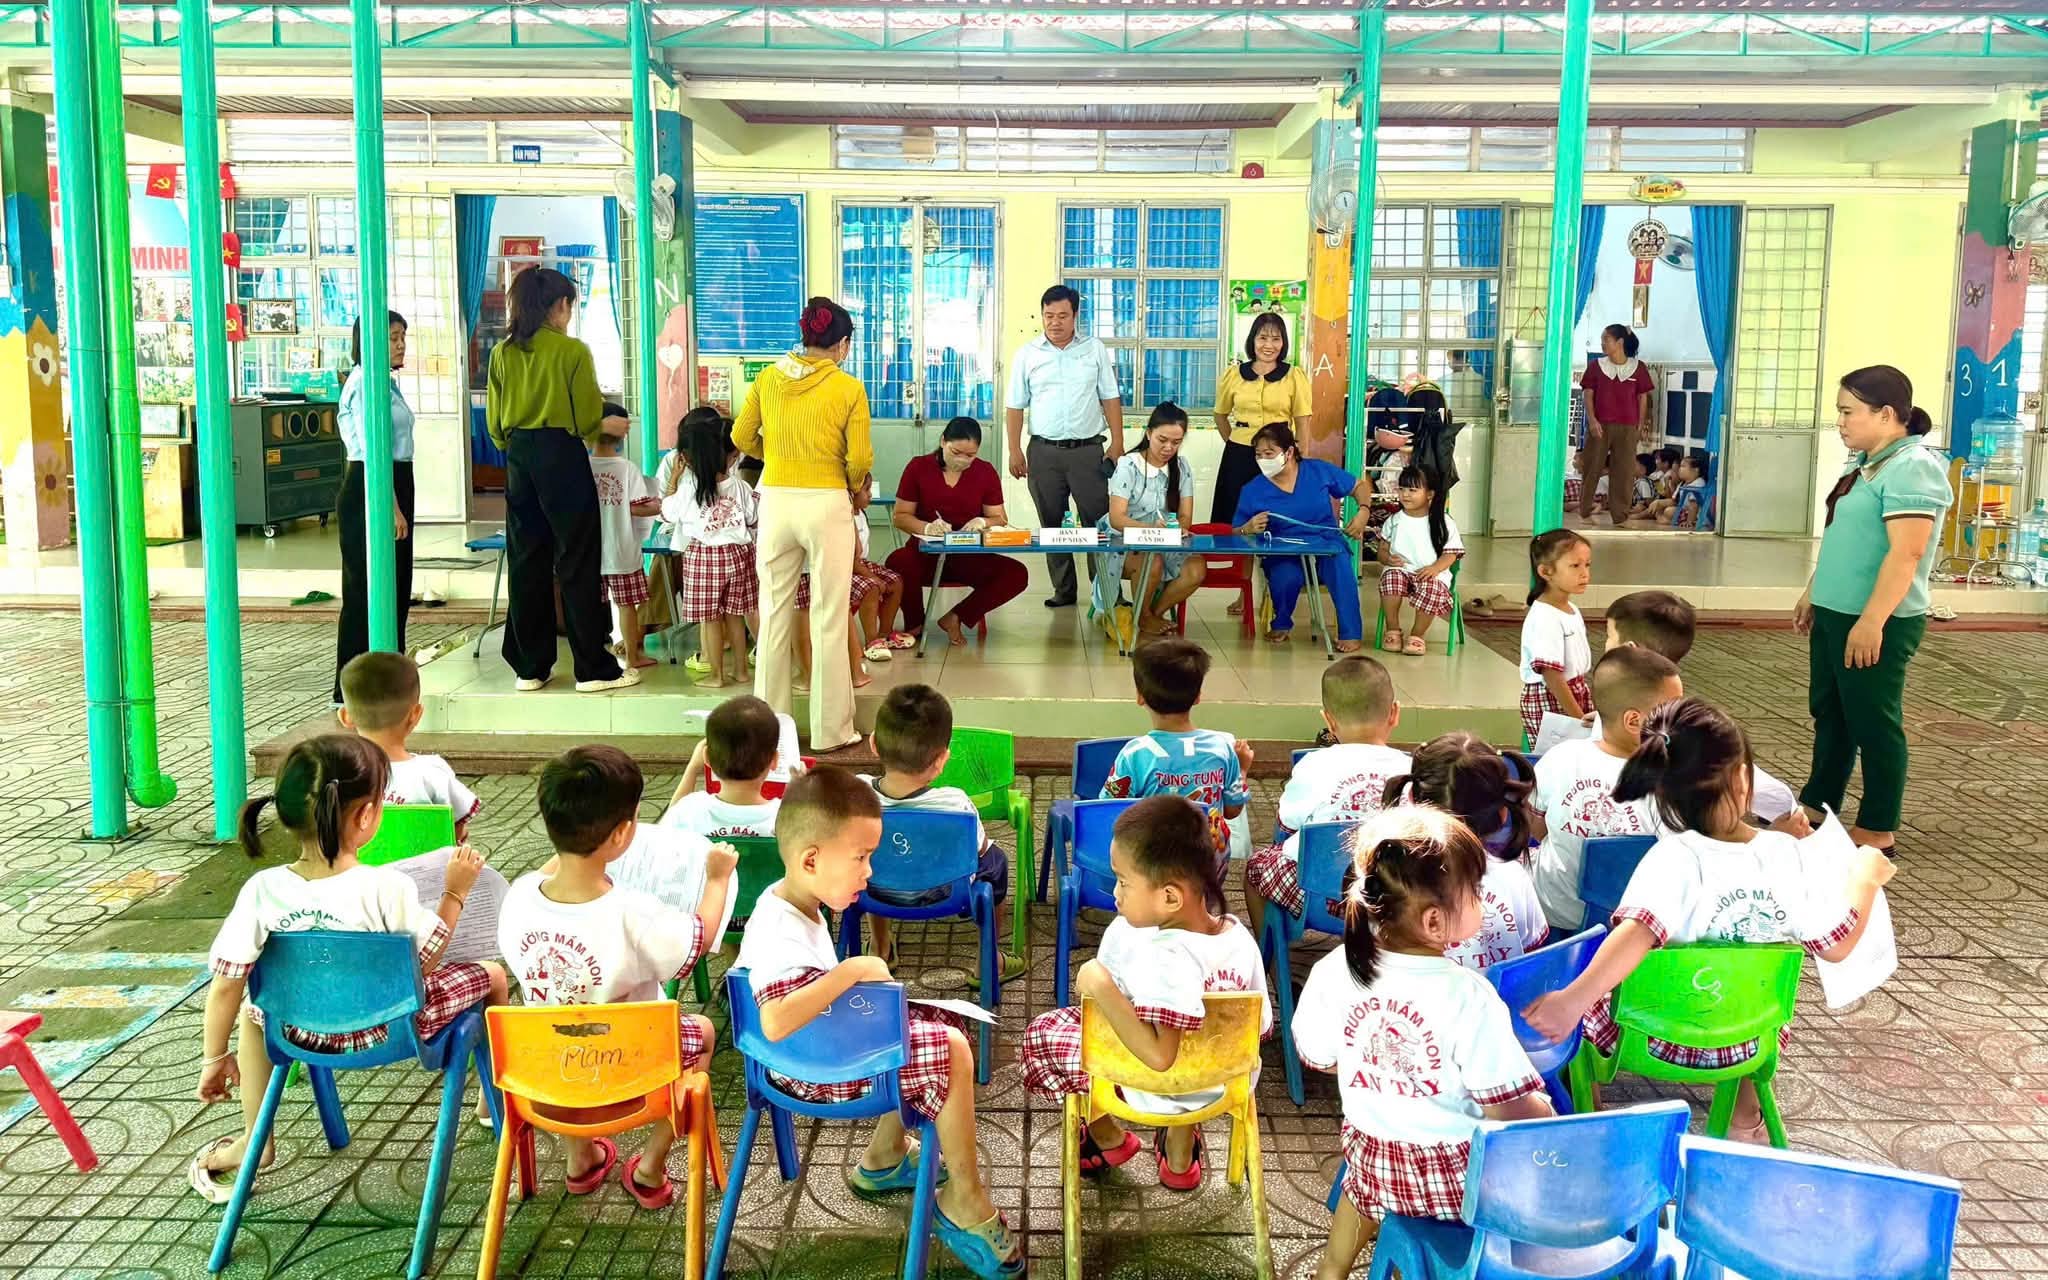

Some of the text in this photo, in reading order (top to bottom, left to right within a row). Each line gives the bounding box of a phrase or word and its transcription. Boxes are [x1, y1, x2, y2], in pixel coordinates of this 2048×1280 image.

[131, 246, 188, 270] MINH
[654, 273, 679, 306] N
[1313, 353, 1334, 378] A
[1991, 358, 2009, 386] 1
[1961, 363, 1973, 397] 3
[1155, 772, 1190, 786] TUNG
[383, 789, 406, 806] ẦM
[1560, 821, 1591, 838] AN
[1624, 805, 1641, 832] NON
[1496, 902, 1518, 933] NON
[520, 930, 602, 986] ƯỜNG MẦM NON
[524, 987, 550, 1002] N
[1386, 999, 1424, 1028] MẦM
[1422, 1030, 1441, 1070] NON
[1348, 1070, 1442, 1098] AN TÂY
